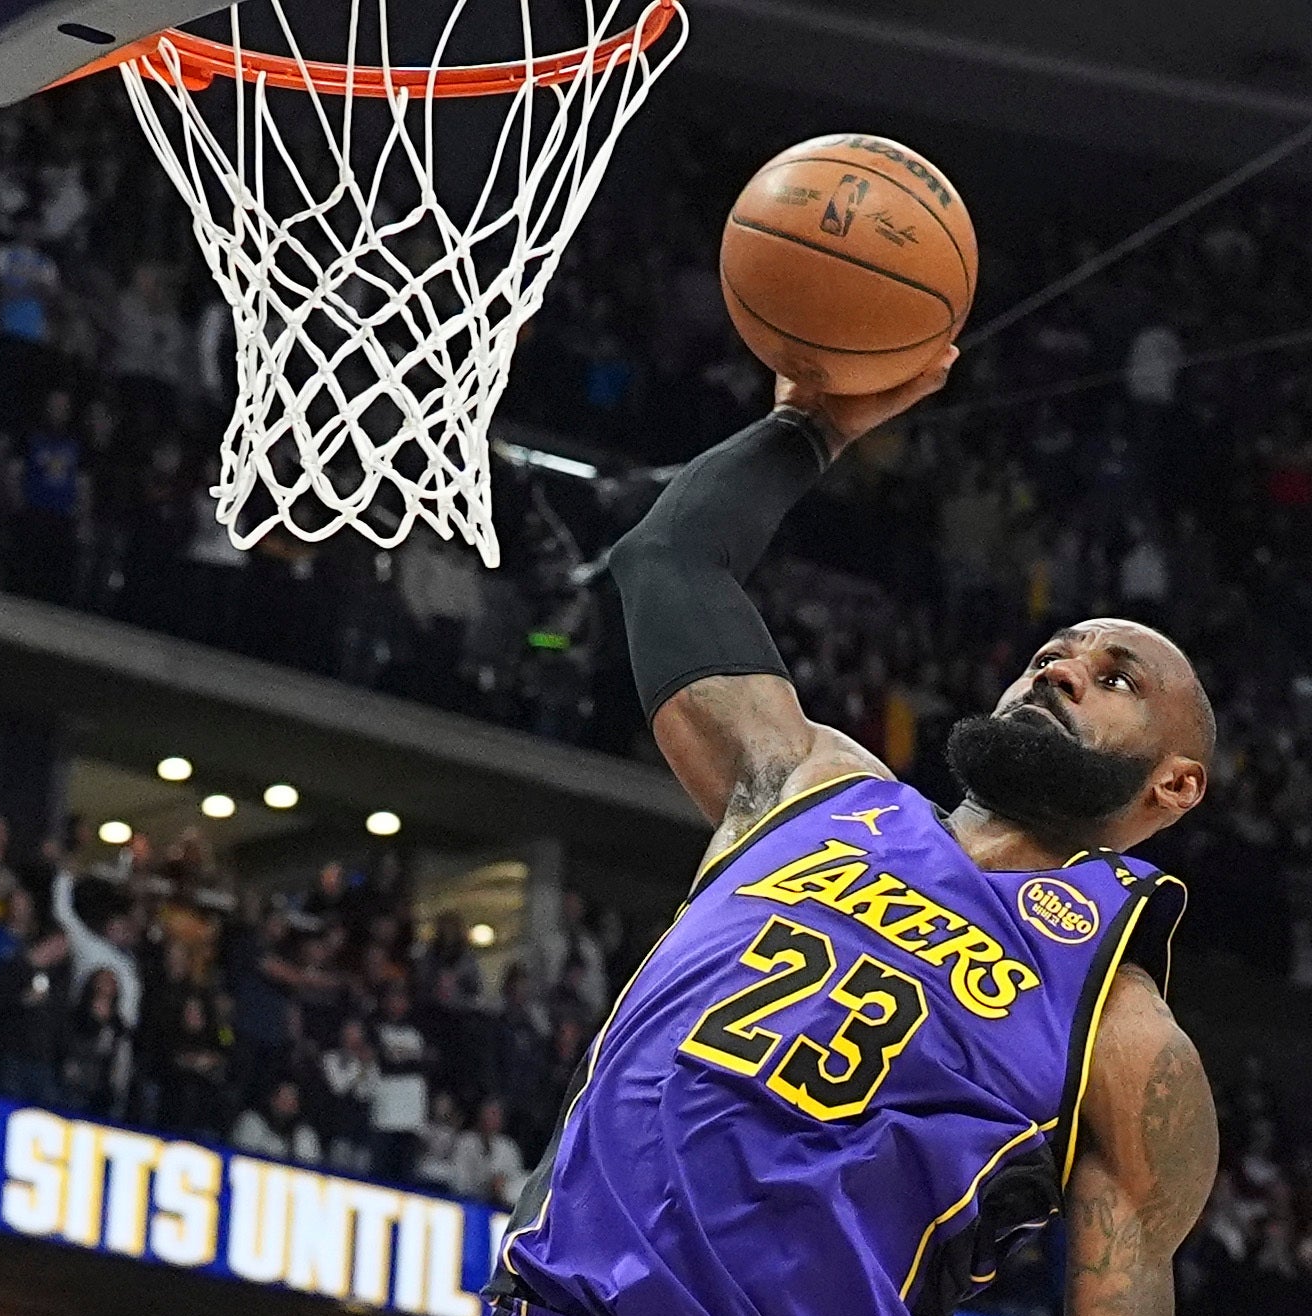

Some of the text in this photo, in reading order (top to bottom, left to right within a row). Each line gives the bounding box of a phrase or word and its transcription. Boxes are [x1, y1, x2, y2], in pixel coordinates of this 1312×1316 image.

[735, 838, 1040, 1019] LAKERS
[1027, 883, 1093, 935] bibigo
[678, 913, 931, 1123] 23
[2, 1107, 221, 1268] SITS
